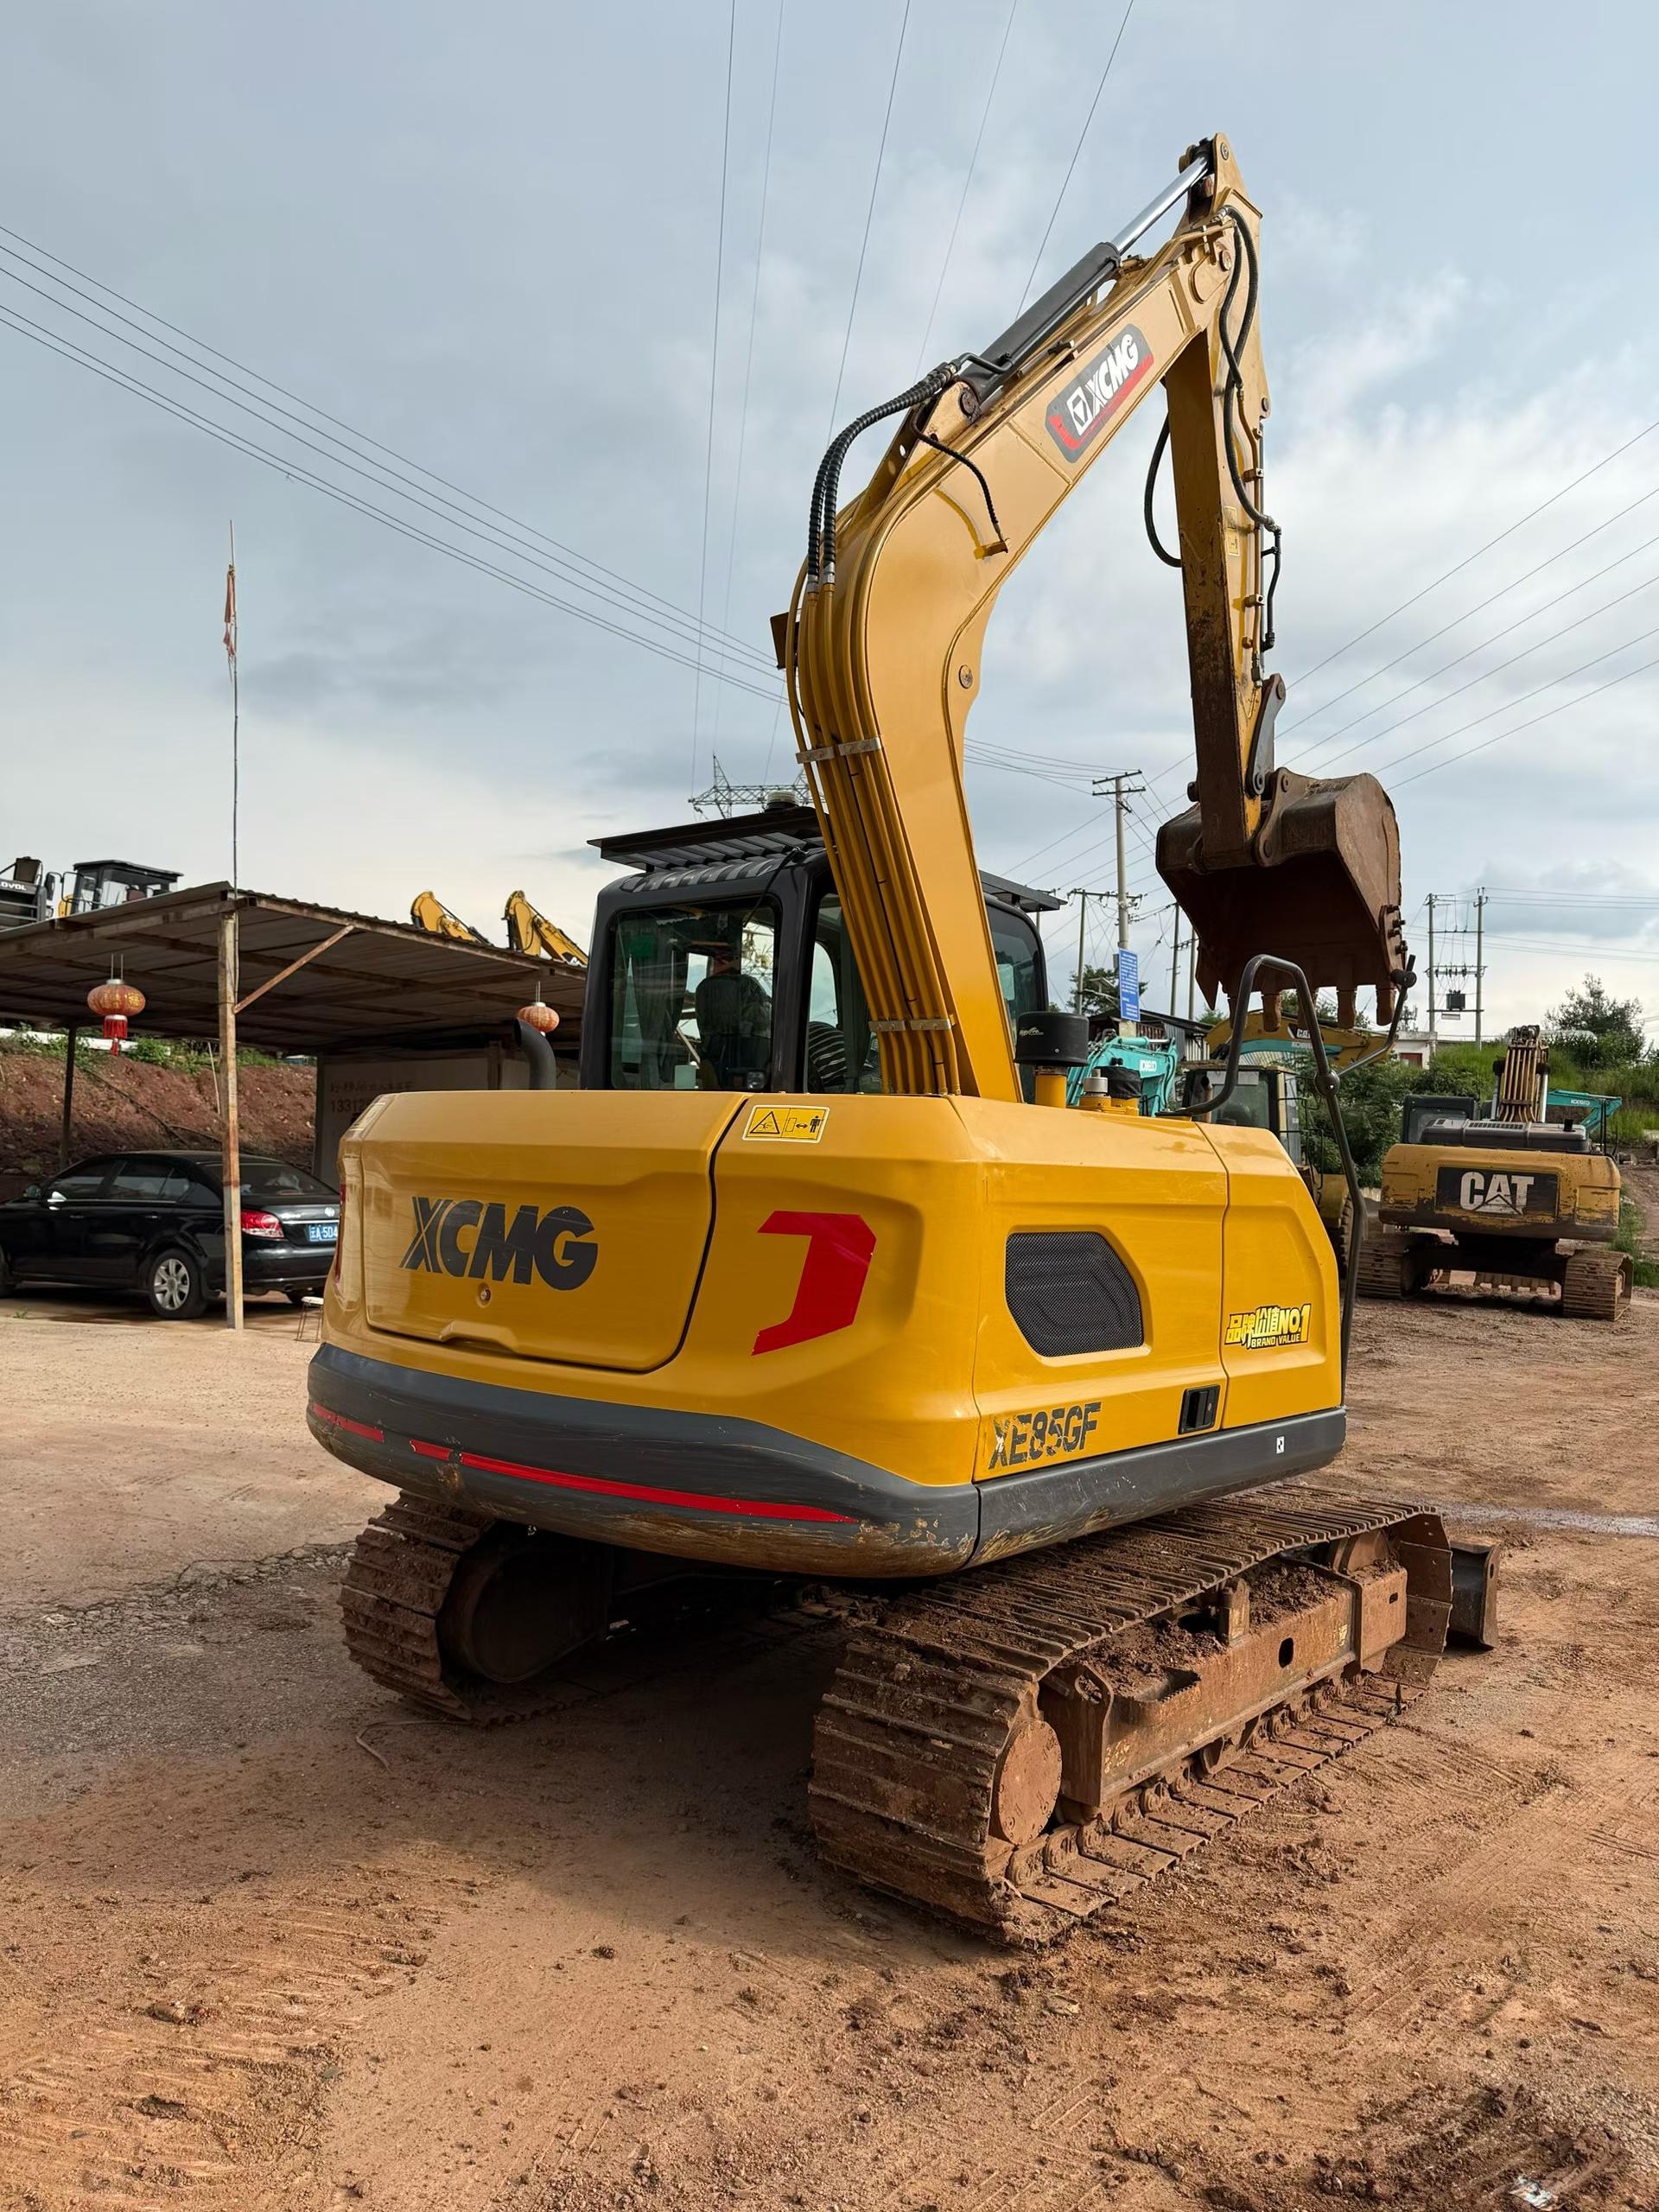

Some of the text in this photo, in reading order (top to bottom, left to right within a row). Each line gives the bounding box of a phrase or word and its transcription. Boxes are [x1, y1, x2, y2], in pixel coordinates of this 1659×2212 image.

[1085, 334, 1139, 420] XCMG
[0, 881, 27, 891] OVOL
[1296, 1028, 1311, 1039] CA
[1460, 1172, 1535, 1215] CAT
[398, 1197, 598, 1291] XCMG
[1251, 1333, 1300, 1349] BRAND VALUE
[988, 1402, 1102, 1470] XE85GF
